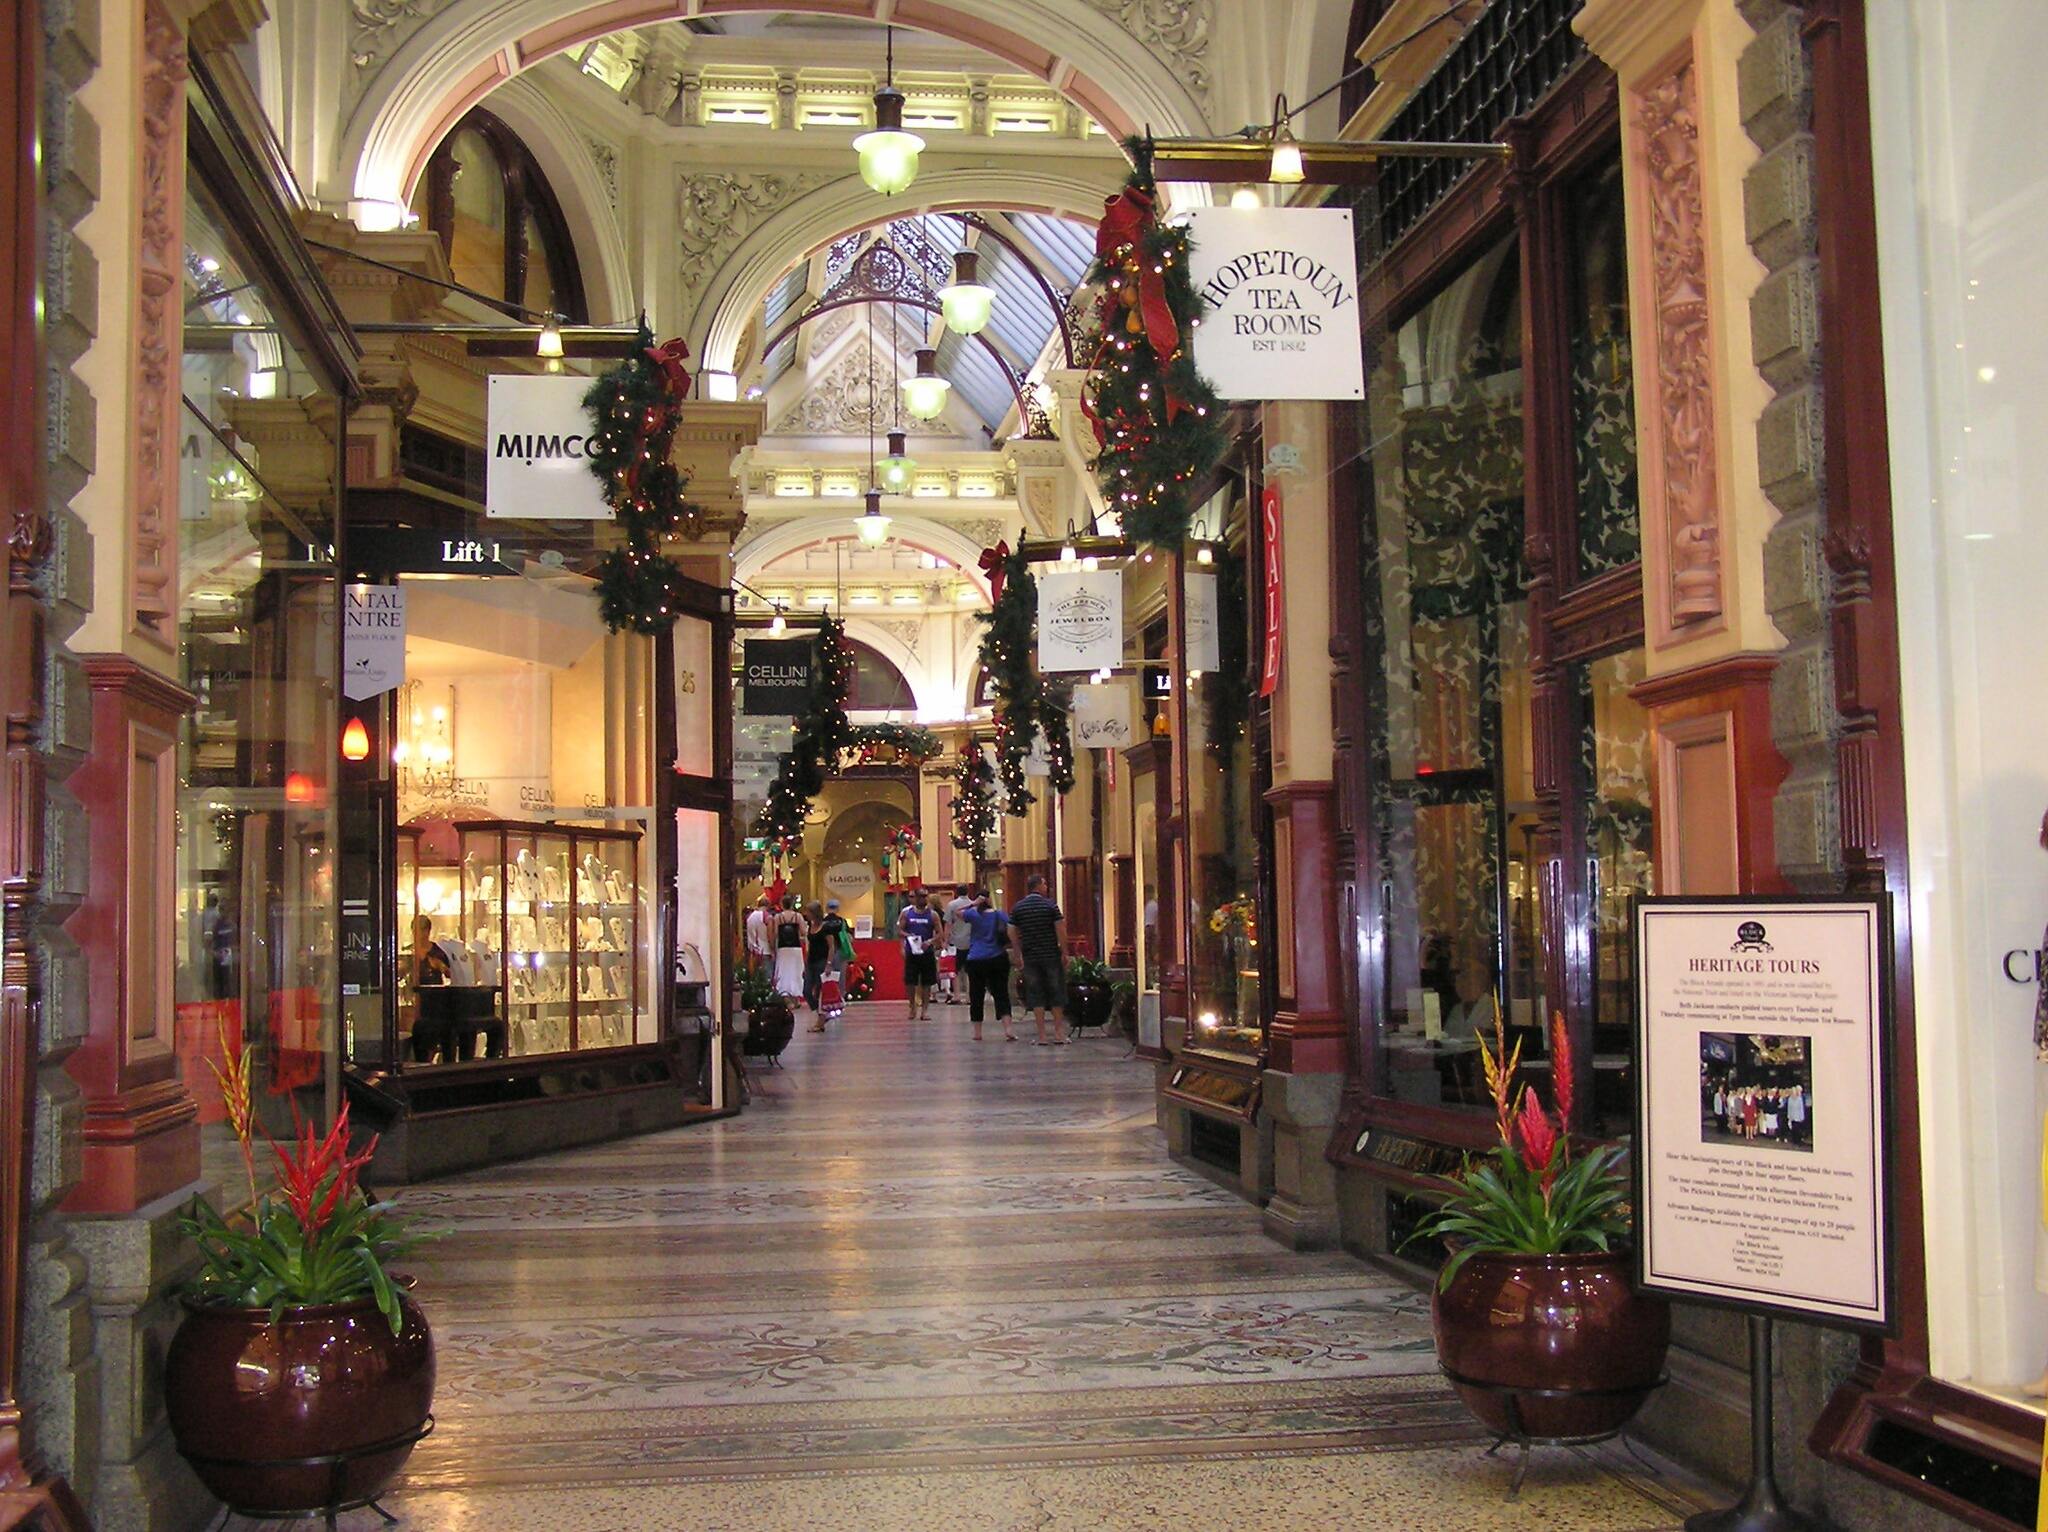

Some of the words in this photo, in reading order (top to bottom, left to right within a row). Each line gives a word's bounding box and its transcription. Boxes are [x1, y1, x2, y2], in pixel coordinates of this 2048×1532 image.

[1200, 250, 1353, 309] HOPETOUN
[1248, 289, 1302, 309] TEA
[1234, 314, 1322, 335] ROOMS
[1252, 340, 1275, 351] EST
[442, 541, 484, 562] Lift
[492, 542, 500, 562] 1
[1266, 500, 1279, 678] SALE
[1050, 616, 1110, 624] JEWELBOX
[748, 665, 807, 678] CELLINI
[748, 679, 807, 687] MELBOURNE
[1689, 958, 1764, 973] HERITAGE
[1767, 959, 1820, 974] TOURS
